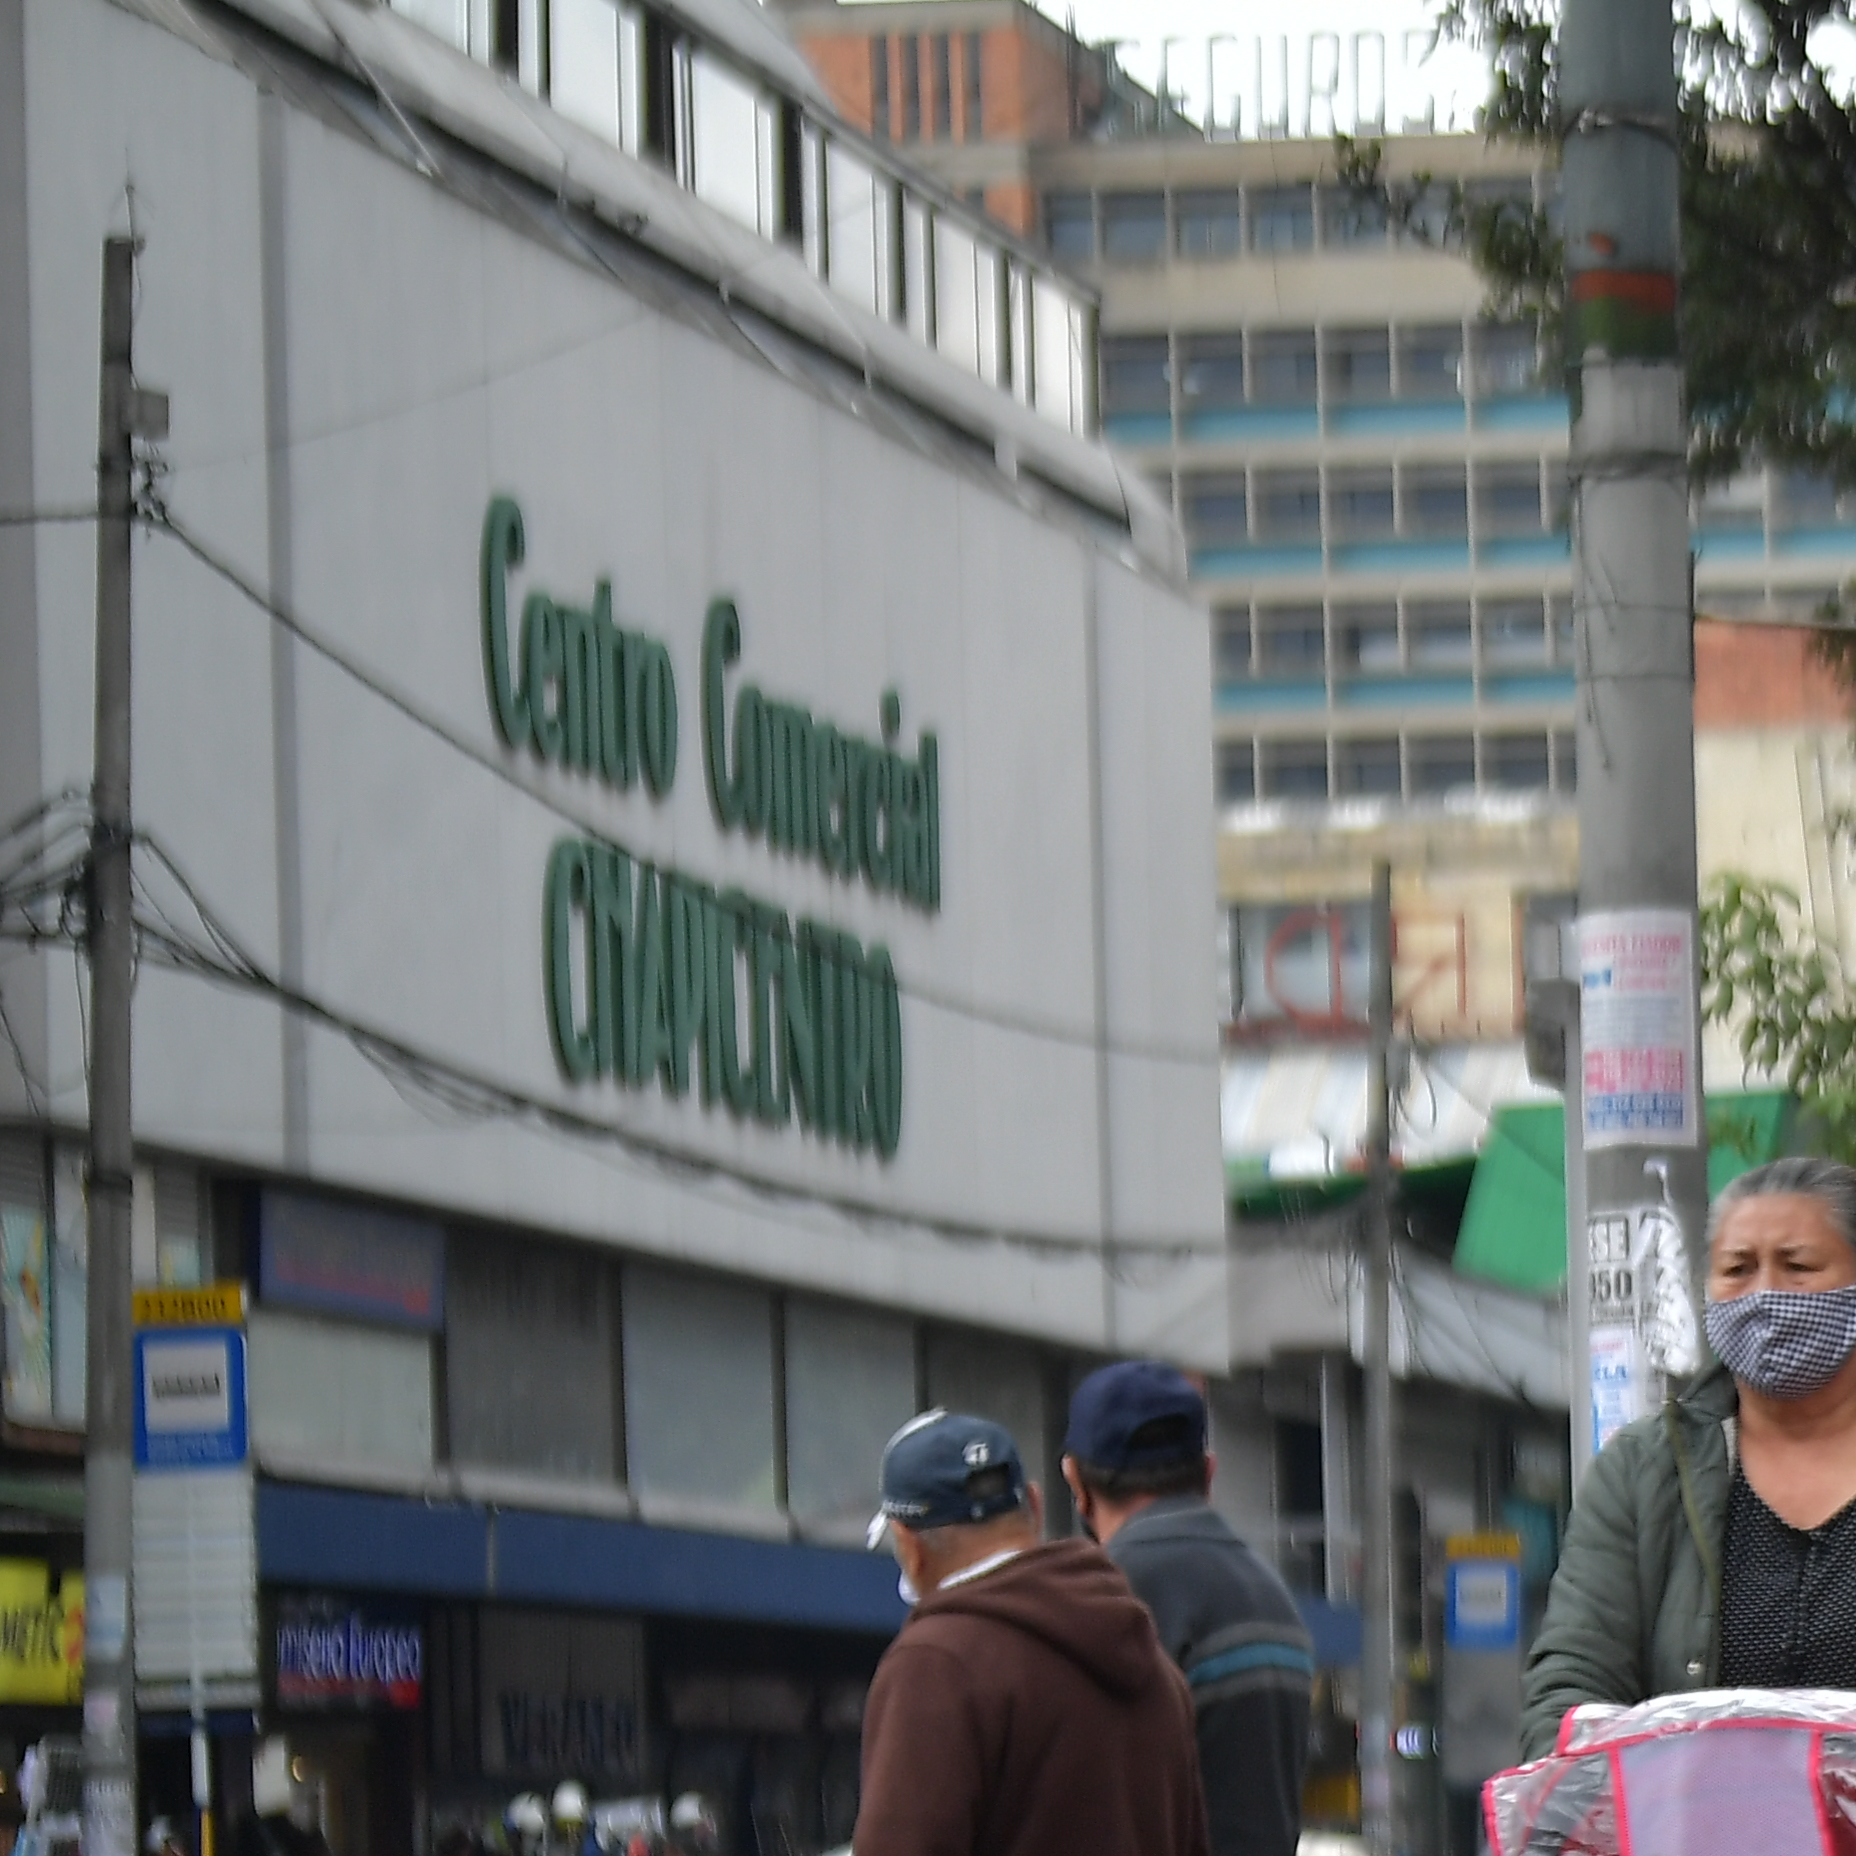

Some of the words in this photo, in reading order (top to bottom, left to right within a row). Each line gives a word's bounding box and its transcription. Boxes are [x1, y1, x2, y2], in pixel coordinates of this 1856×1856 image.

[482, 494, 677, 799] Centro
[702, 597, 941, 917] Comercial
[543, 835, 902, 1165] CHAPICENTRO
